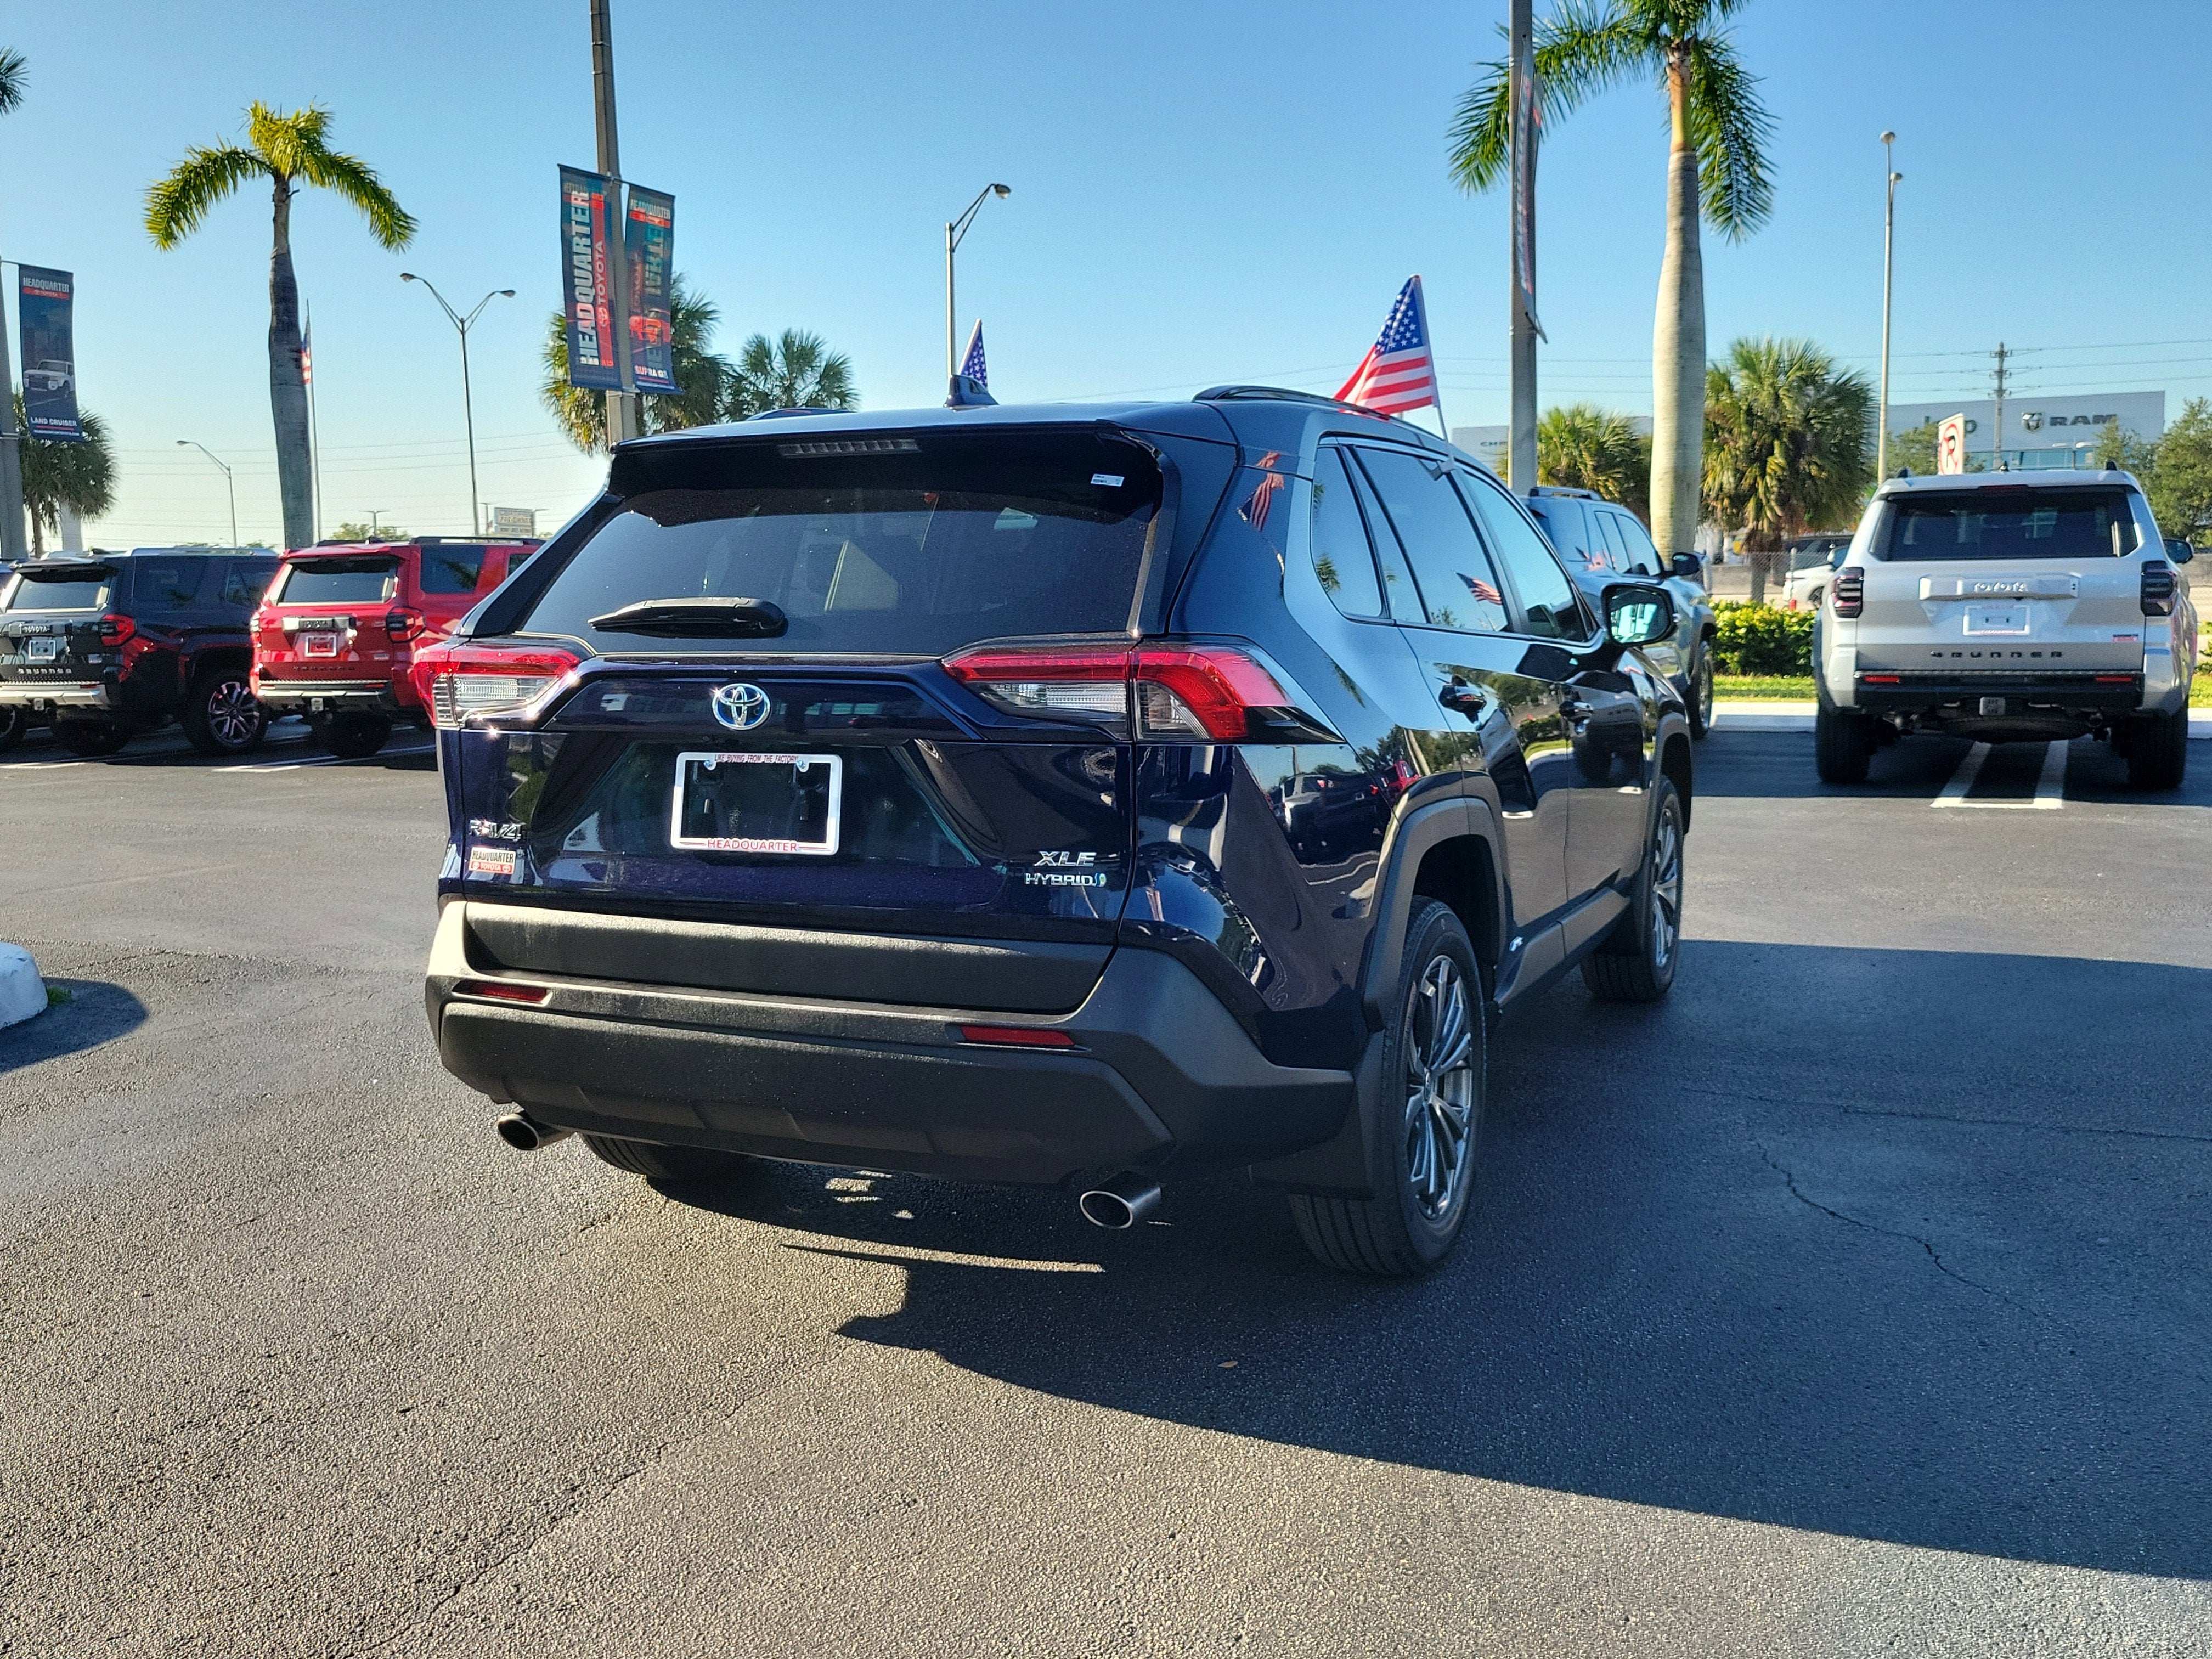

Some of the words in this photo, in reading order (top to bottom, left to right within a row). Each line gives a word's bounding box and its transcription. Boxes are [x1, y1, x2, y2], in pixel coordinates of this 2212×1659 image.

[571, 190, 600, 366] HEADQUARTER
[595, 240, 608, 306] TOYOTA
[22, 277, 70, 293] HEADQUARTER
[30, 416, 48, 425] LAND
[49, 419, 77, 427] CRUISER
[2049, 414, 2118, 427] RAM
[714, 754, 725, 762] LIKE
[727, 754, 745, 762] BUYING
[707, 839, 797, 851] HEADQUARTER
[472, 850, 514, 864] HEADQUARTER
[1034, 851, 1097, 867] XLE
[480, 863, 501, 871] TOYOTA
[1024, 872, 1094, 886] HYBRID
